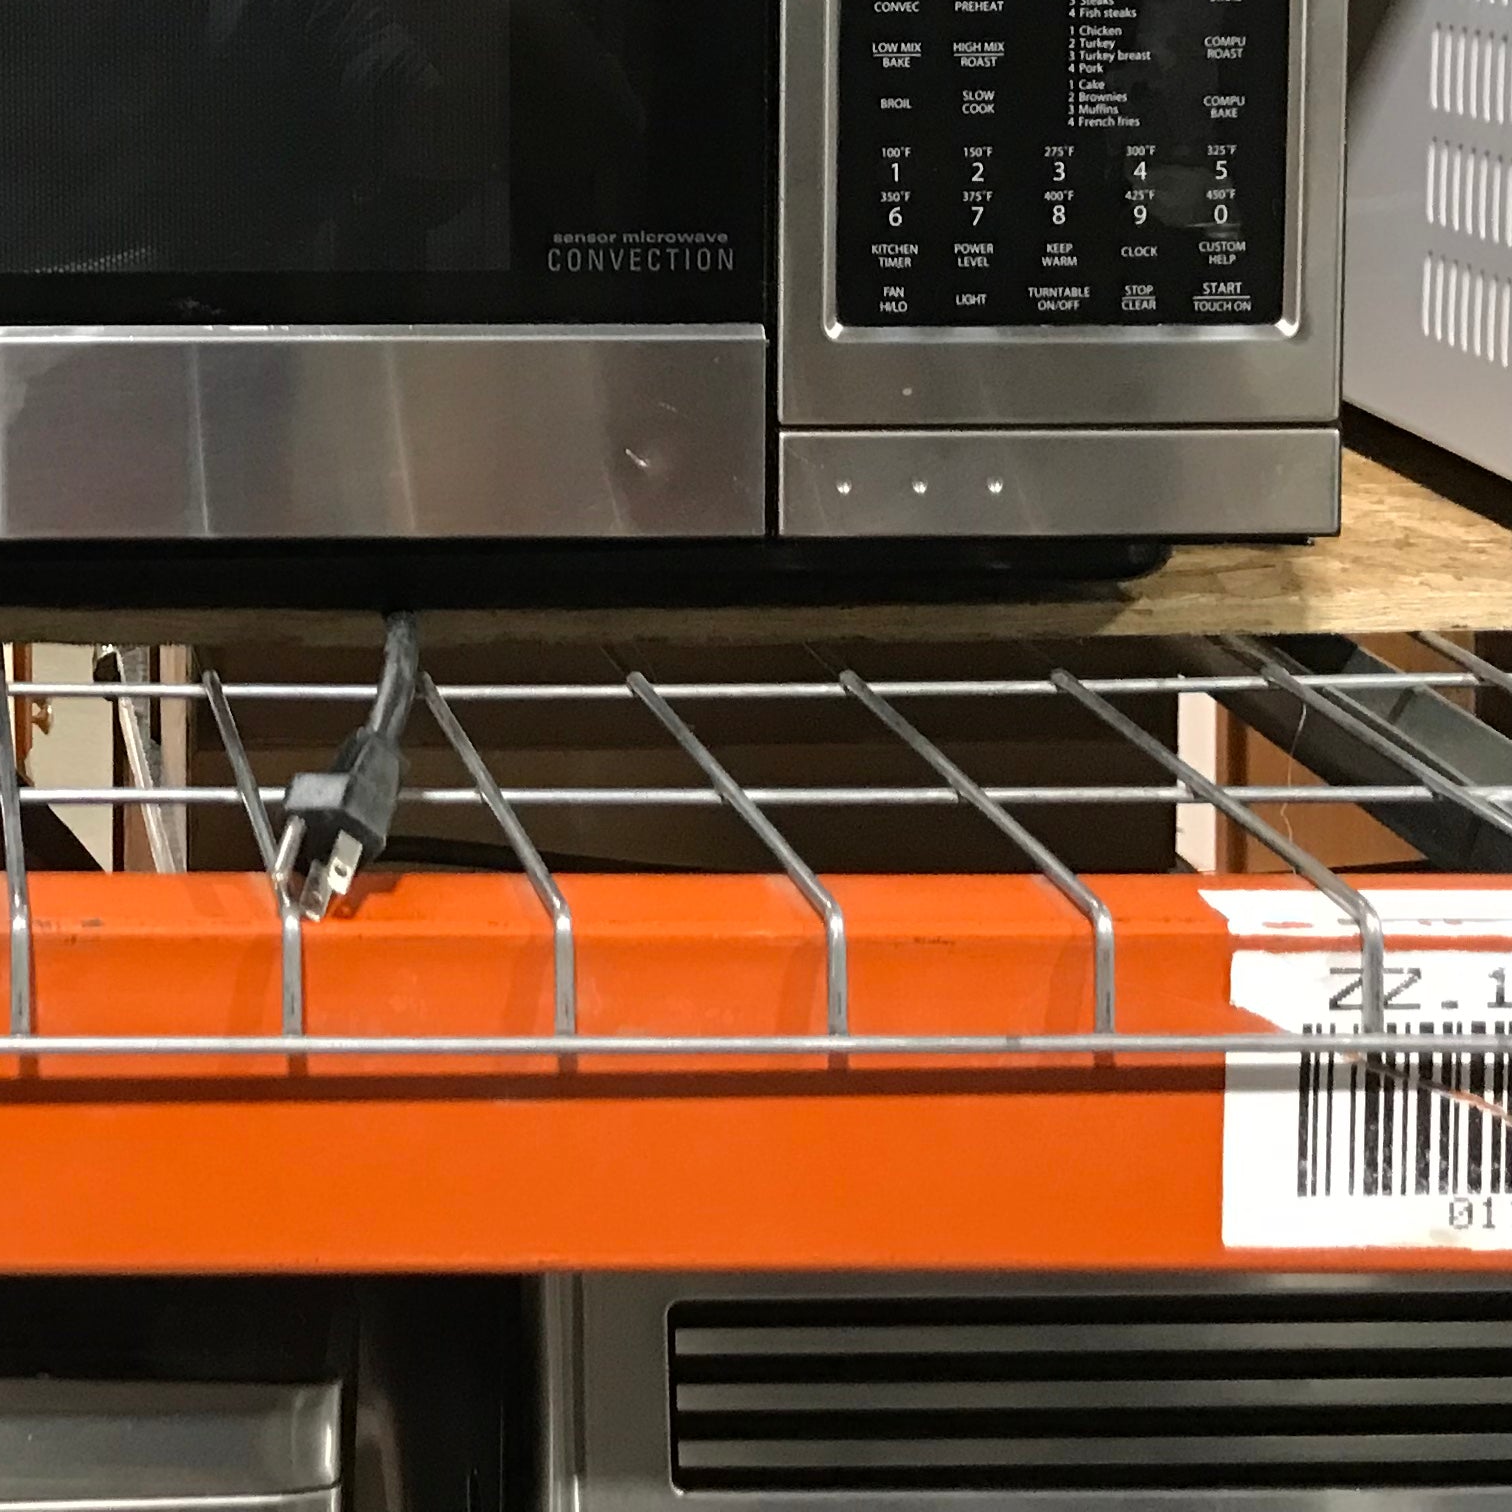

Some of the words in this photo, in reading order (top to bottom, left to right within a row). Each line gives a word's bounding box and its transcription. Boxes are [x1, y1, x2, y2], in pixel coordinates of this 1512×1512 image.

[874, 2, 920, 12] CONVEC
[955, 1, 1004, 11] PREHEAT
[1068, 9, 1075, 18] 4
[1079, 8, 1101, 18] Fish
[1104, 8, 1136, 18] steaks
[1069, 27, 1075, 36] 1
[1079, 26, 1122, 36] Chicken
[1068, 39, 1075, 49] 2
[1079, 39, 1115, 51] Turkey
[1205, 37, 1246, 47] COMPU
[873, 43, 897, 53] LOW
[901, 43, 921, 53] MIX
[953, 43, 980, 52] HIGH
[984, 43, 1004, 52] MIX
[1068, 52, 1075, 61] 3
[1079, 51, 1115, 64] Turkey
[1118, 51, 1150, 61] breast
[1207, 49, 1243, 59] ROAST
[882, 58, 910, 67] BAKE
[961, 57, 997, 67] ROAST
[1068, 64, 1075, 73] 4
[1079, 63, 1103, 73] Pork
[1069, 81, 1075, 90] 1
[1079, 80, 1105, 90] Cake
[963, 91, 994, 101] SLOW
[1068, 92, 1075, 102] 2
[1078, 92, 1127, 102] Brownies
[880, 98, 911, 109] BROIL
[1203, 96, 1245, 107] COMPU
[962, 104, 994, 114] COOK
[1068, 105, 1075, 114] 3
[1078, 104, 1118, 114] Muffins
[1210, 108, 1238, 118] BAKE
[1068, 117, 1075, 127] 4
[1078, 117, 1115, 127] French
[1118, 117, 1140, 127] fries
[882, 147, 911, 157] 100°F
[964, 147, 992, 157] 150°F
[1045, 146, 1074, 157] 275°F
[1126, 145, 1156, 156] 300°F
[892, 163, 899, 182] 1
[971, 162, 984, 182] 2
[1053, 162, 1065, 181] 3
[1134, 161, 1147, 180] 4
[1215, 161, 1227, 180] 5
[880, 192, 910, 202] 350°F
[963, 191, 992, 202] 375°F
[1044, 190, 1074, 201] 400°F
[1125, 190, 1155, 200] 425°F
[1206, 189, 1236, 200] 450°F
[889, 207, 902, 227] 6
[971, 206, 984, 226] 7
[1052, 205, 1065, 224] 8
[1133, 205, 1147, 225] 9
[1214, 204, 1228, 224] 0
[553, 233, 617, 243] sensor
[623, 230, 728, 243] microwave
[871, 245, 918, 255] KITCHEN
[954, 244, 993, 254] POWER
[1046, 243, 1073, 254] KEEP
[1121, 246, 1157, 257] CLOCK
[1199, 241, 1245, 252] CUSTOM
[548, 248, 734, 271] CONVECTION
[879, 257, 911, 268] TIMER
[958, 257, 988, 267] LEVEL
[1042, 257, 1077, 266] WARM
[1209, 254, 1236, 265] HELP
[883, 287, 904, 297] FAN
[1028, 287, 1089, 298] TURNTABLE
[1125, 286, 1153, 296] STOP
[1203, 282, 1242, 294] START
[956, 295, 986, 305] LIGHT
[1038, 300, 1080, 311] ON/OFF
[1122, 300, 1156, 311] CLEAR
[1194, 301, 1232, 311] TOUCH
[1233, 301, 1251, 311] ON
